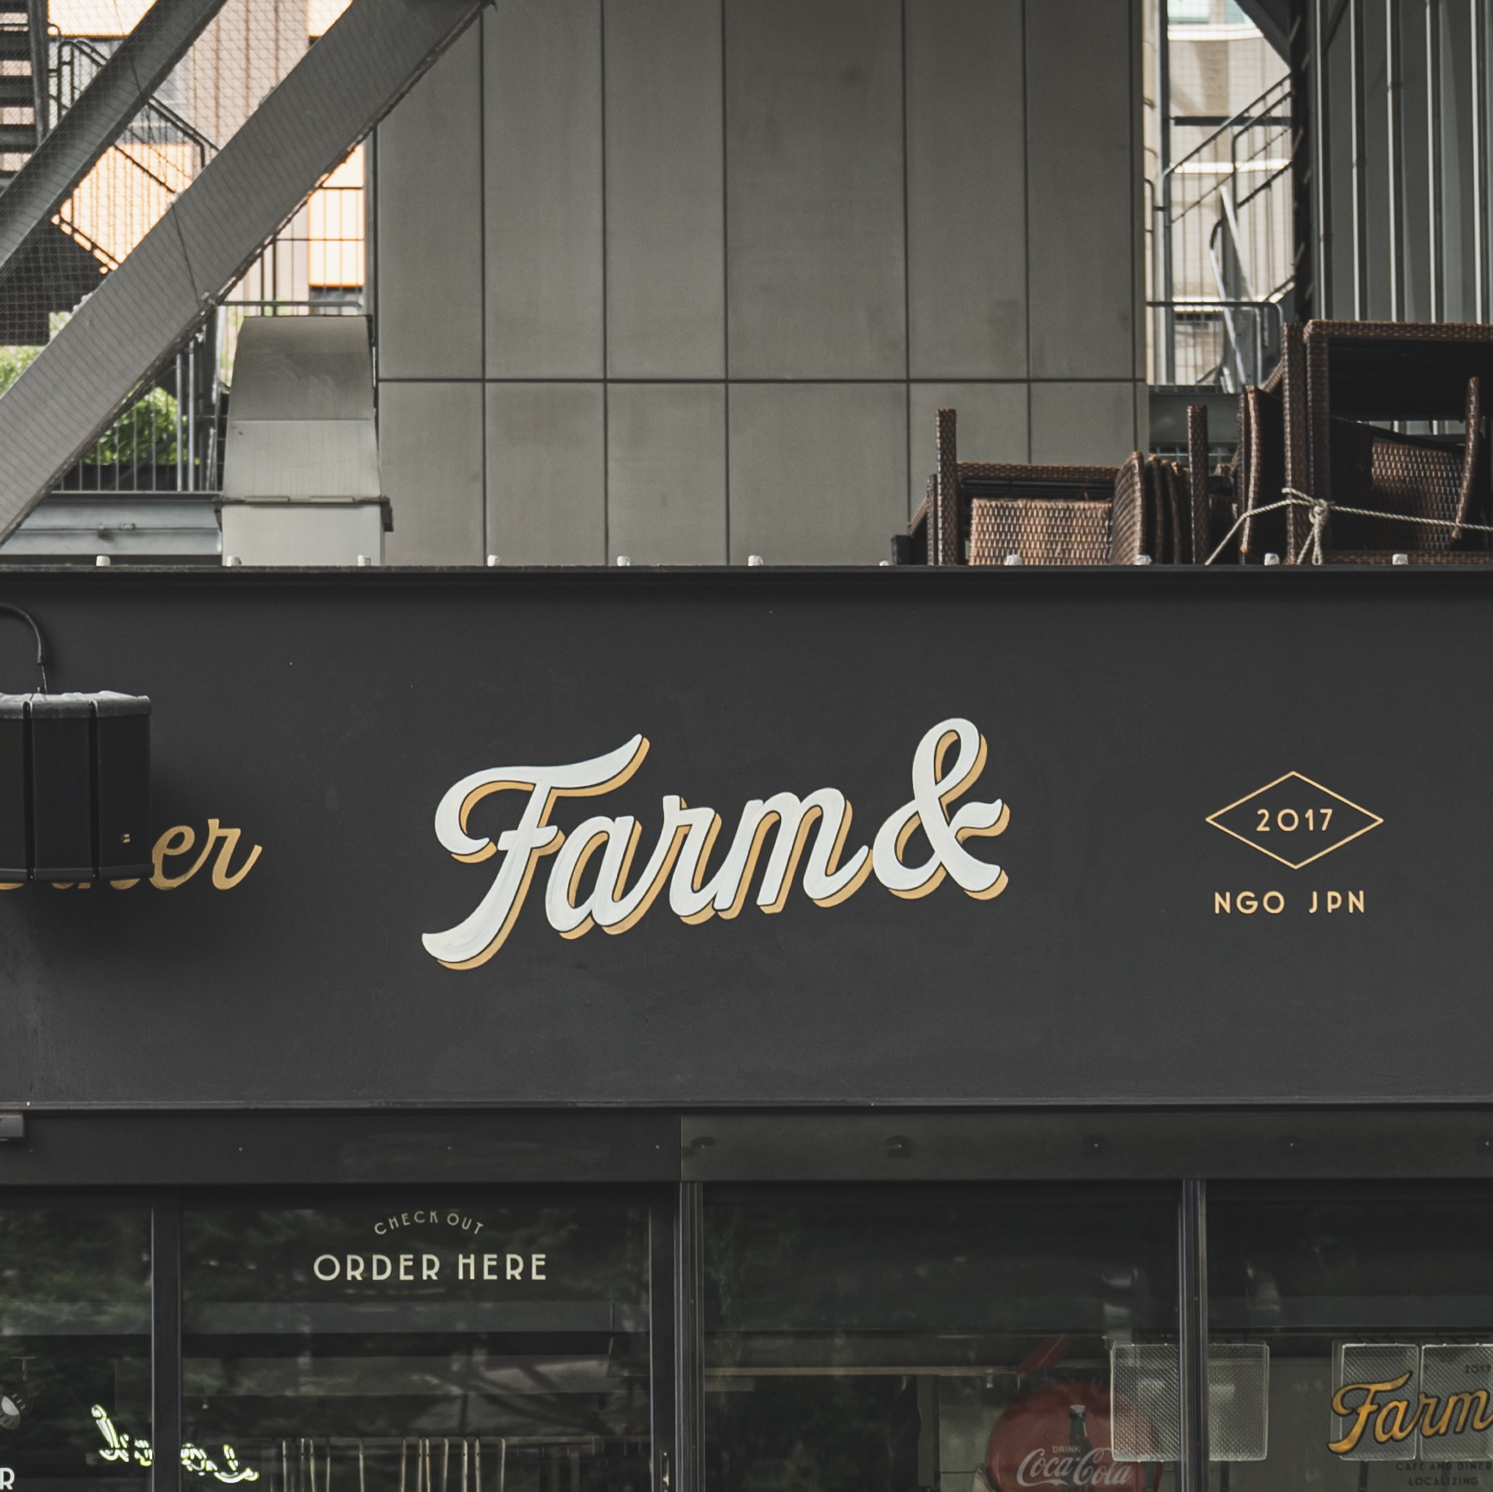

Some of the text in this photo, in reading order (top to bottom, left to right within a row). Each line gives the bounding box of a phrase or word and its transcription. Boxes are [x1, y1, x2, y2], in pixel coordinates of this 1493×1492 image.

[1255, 806, 1335, 833] 2017
[422, 718, 1010, 970] Farm&
[1215, 890, 1366, 914] NGO JPN
[374, 1211, 484, 1236] CHECK OUT
[313, 1254, 547, 1281] ORDER HERE
[1052, 1445, 1081, 1454] DRINK
[1016, 1447, 1133, 1487] Coca-Cola
[1396, 1462, 1493, 1471] CAFE AND DINER
[1408, 1477, 1479, 1486] LOCALIZING
